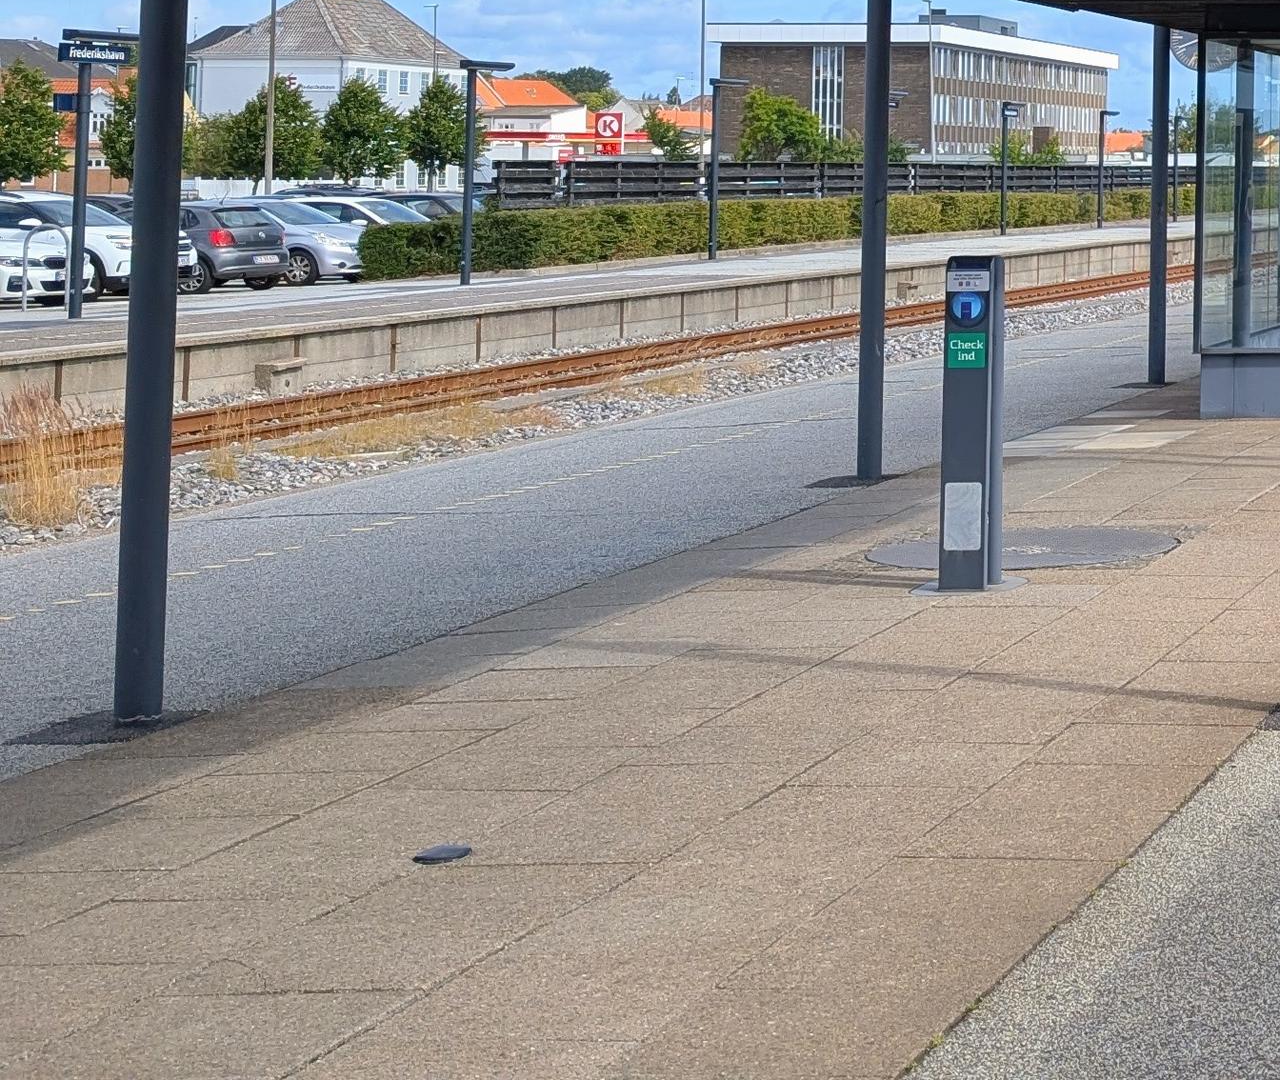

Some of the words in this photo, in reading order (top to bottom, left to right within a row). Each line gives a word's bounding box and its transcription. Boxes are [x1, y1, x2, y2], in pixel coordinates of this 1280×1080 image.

[69, 46, 125, 60] Frederikshavn
[602, 119, 615, 133] K
[950, 340, 984, 350] Check
